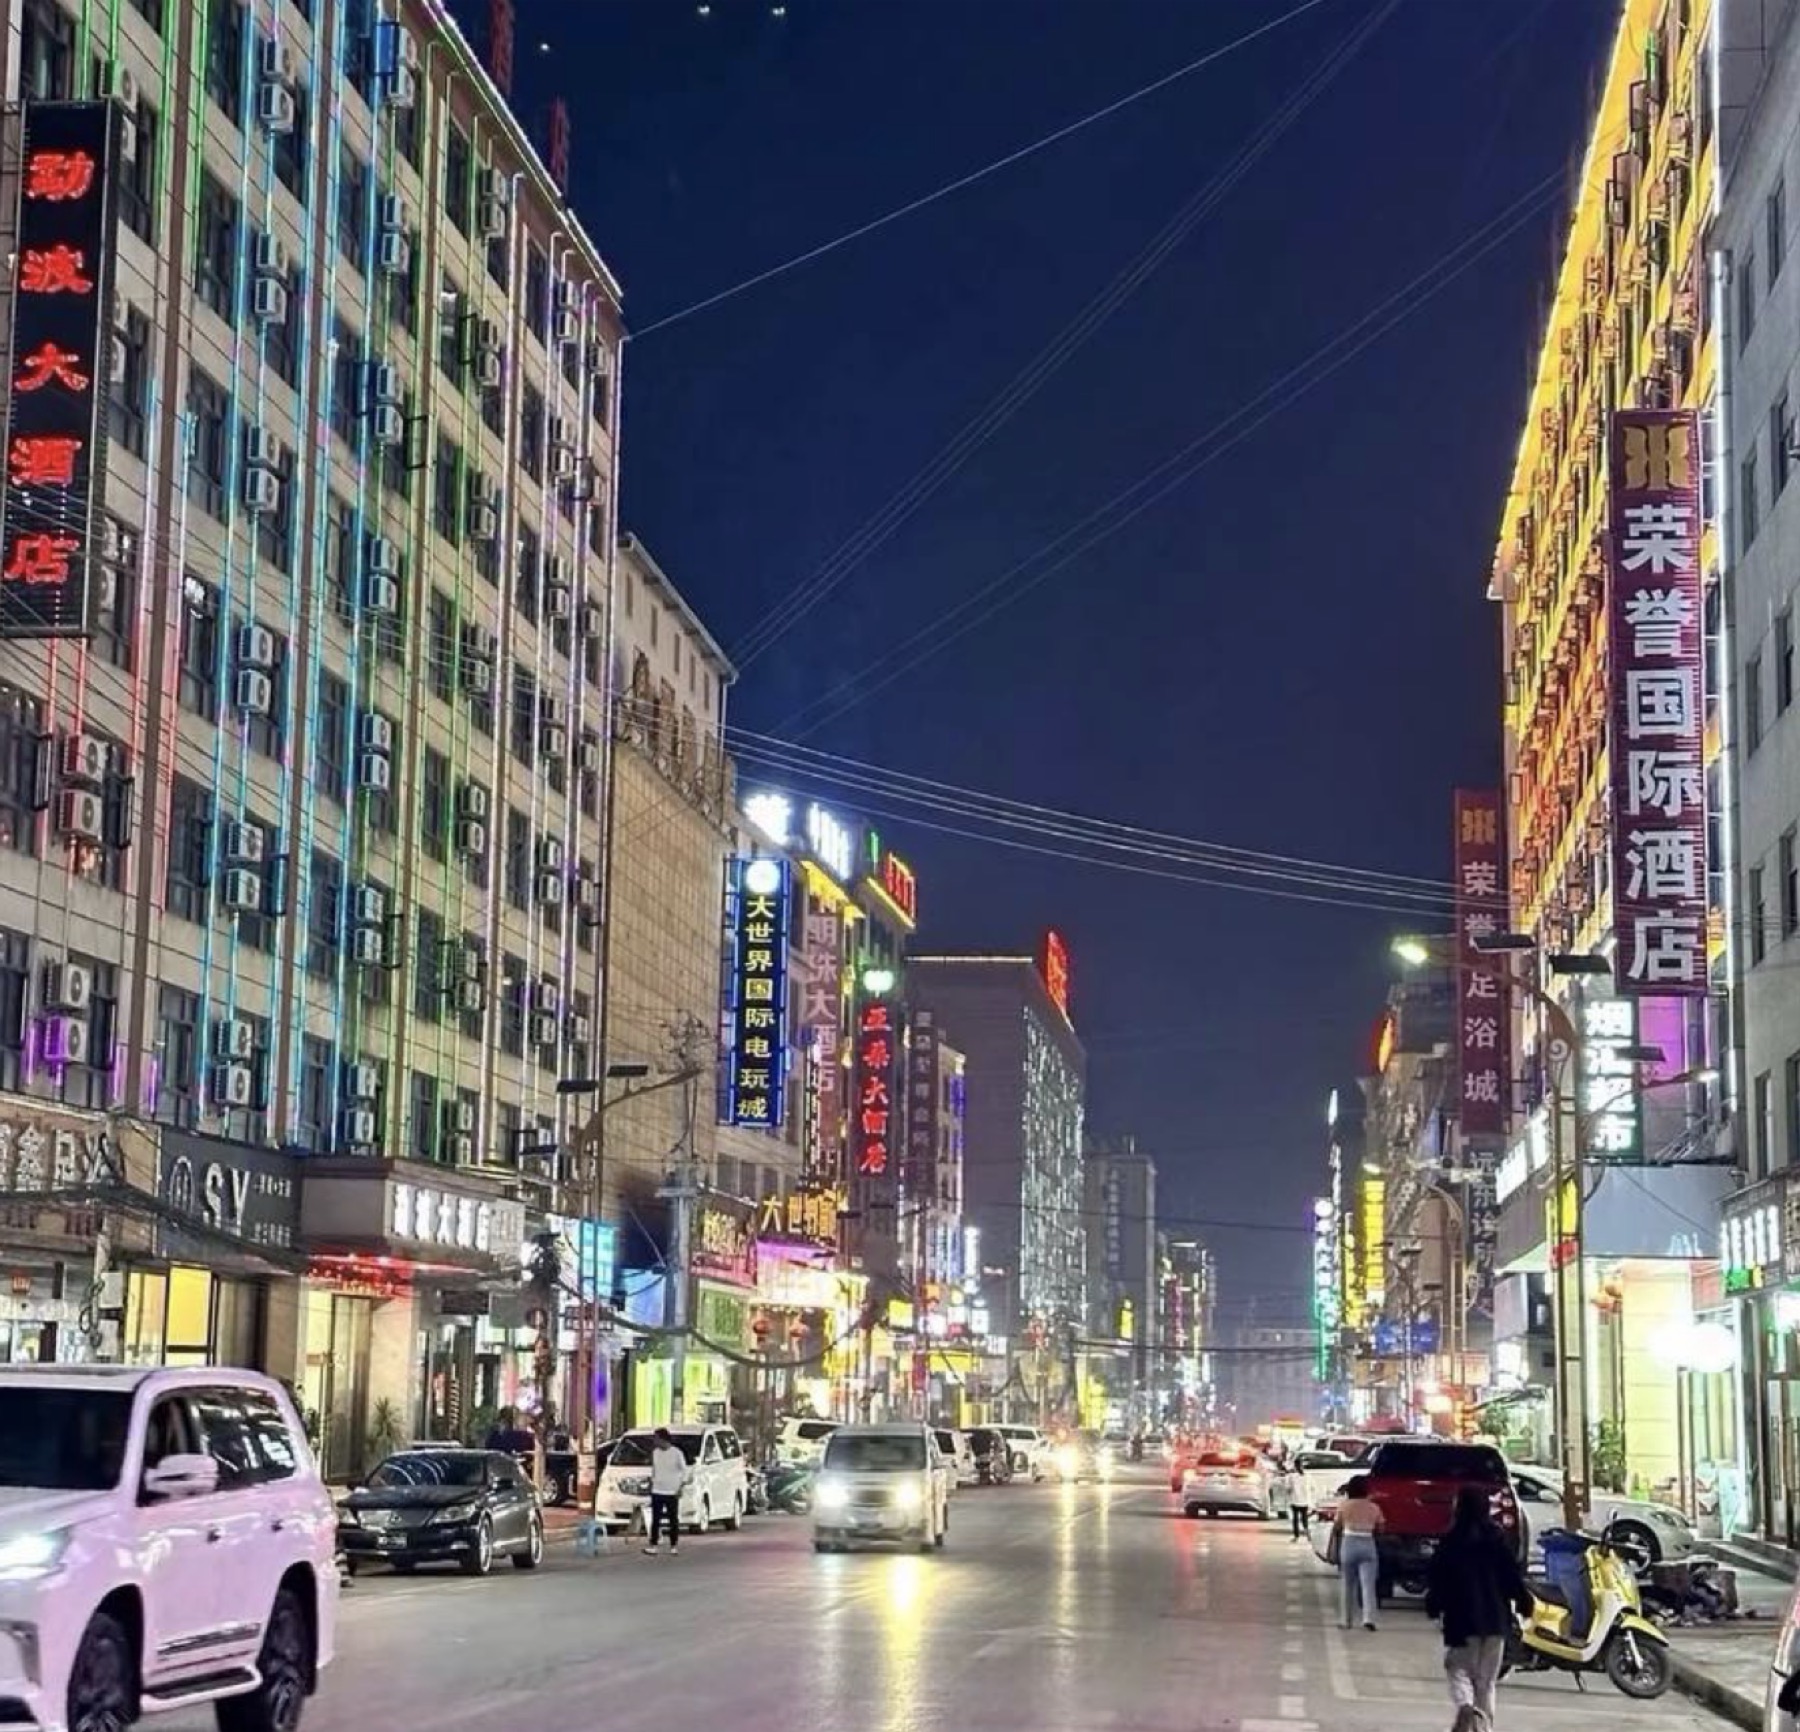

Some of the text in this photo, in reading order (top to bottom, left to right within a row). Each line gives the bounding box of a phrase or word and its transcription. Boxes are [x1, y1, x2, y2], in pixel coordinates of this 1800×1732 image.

[1621, 502, 1704, 984] 荣誉国际酒店
[737, 895, 776, 1119] 大世界国际电玩城
[1462, 861, 1499, 1102] 荣誉足浴城
